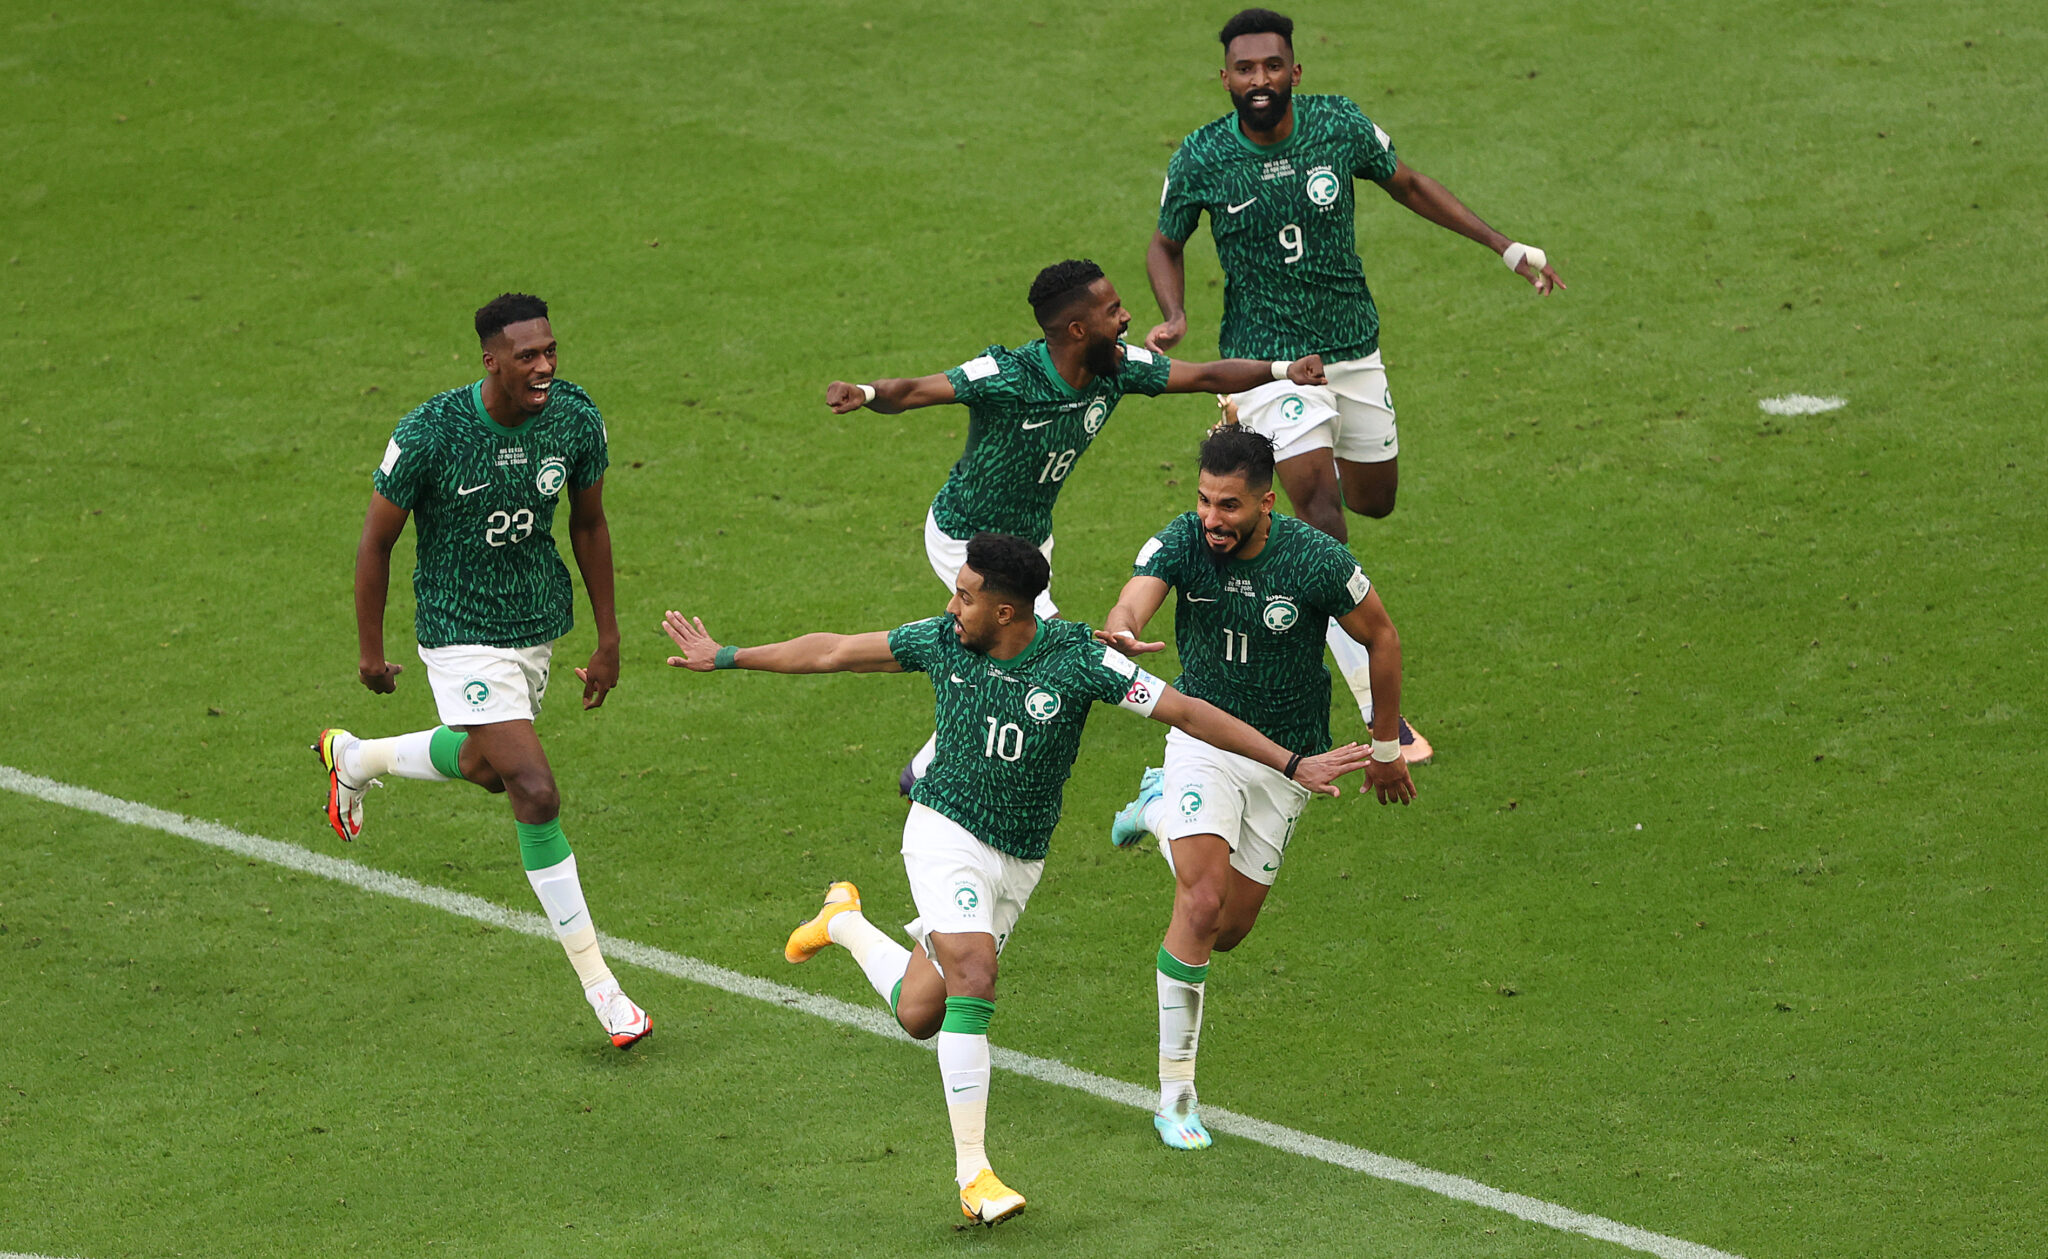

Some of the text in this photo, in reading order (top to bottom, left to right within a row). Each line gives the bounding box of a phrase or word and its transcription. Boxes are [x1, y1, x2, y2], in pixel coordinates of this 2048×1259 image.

[1278, 223, 1303, 264] 9
[1038, 449, 1076, 484] 18
[485, 508, 534, 547] 23
[1223, 628, 1247, 663] 11
[985, 716, 1023, 762] 10
